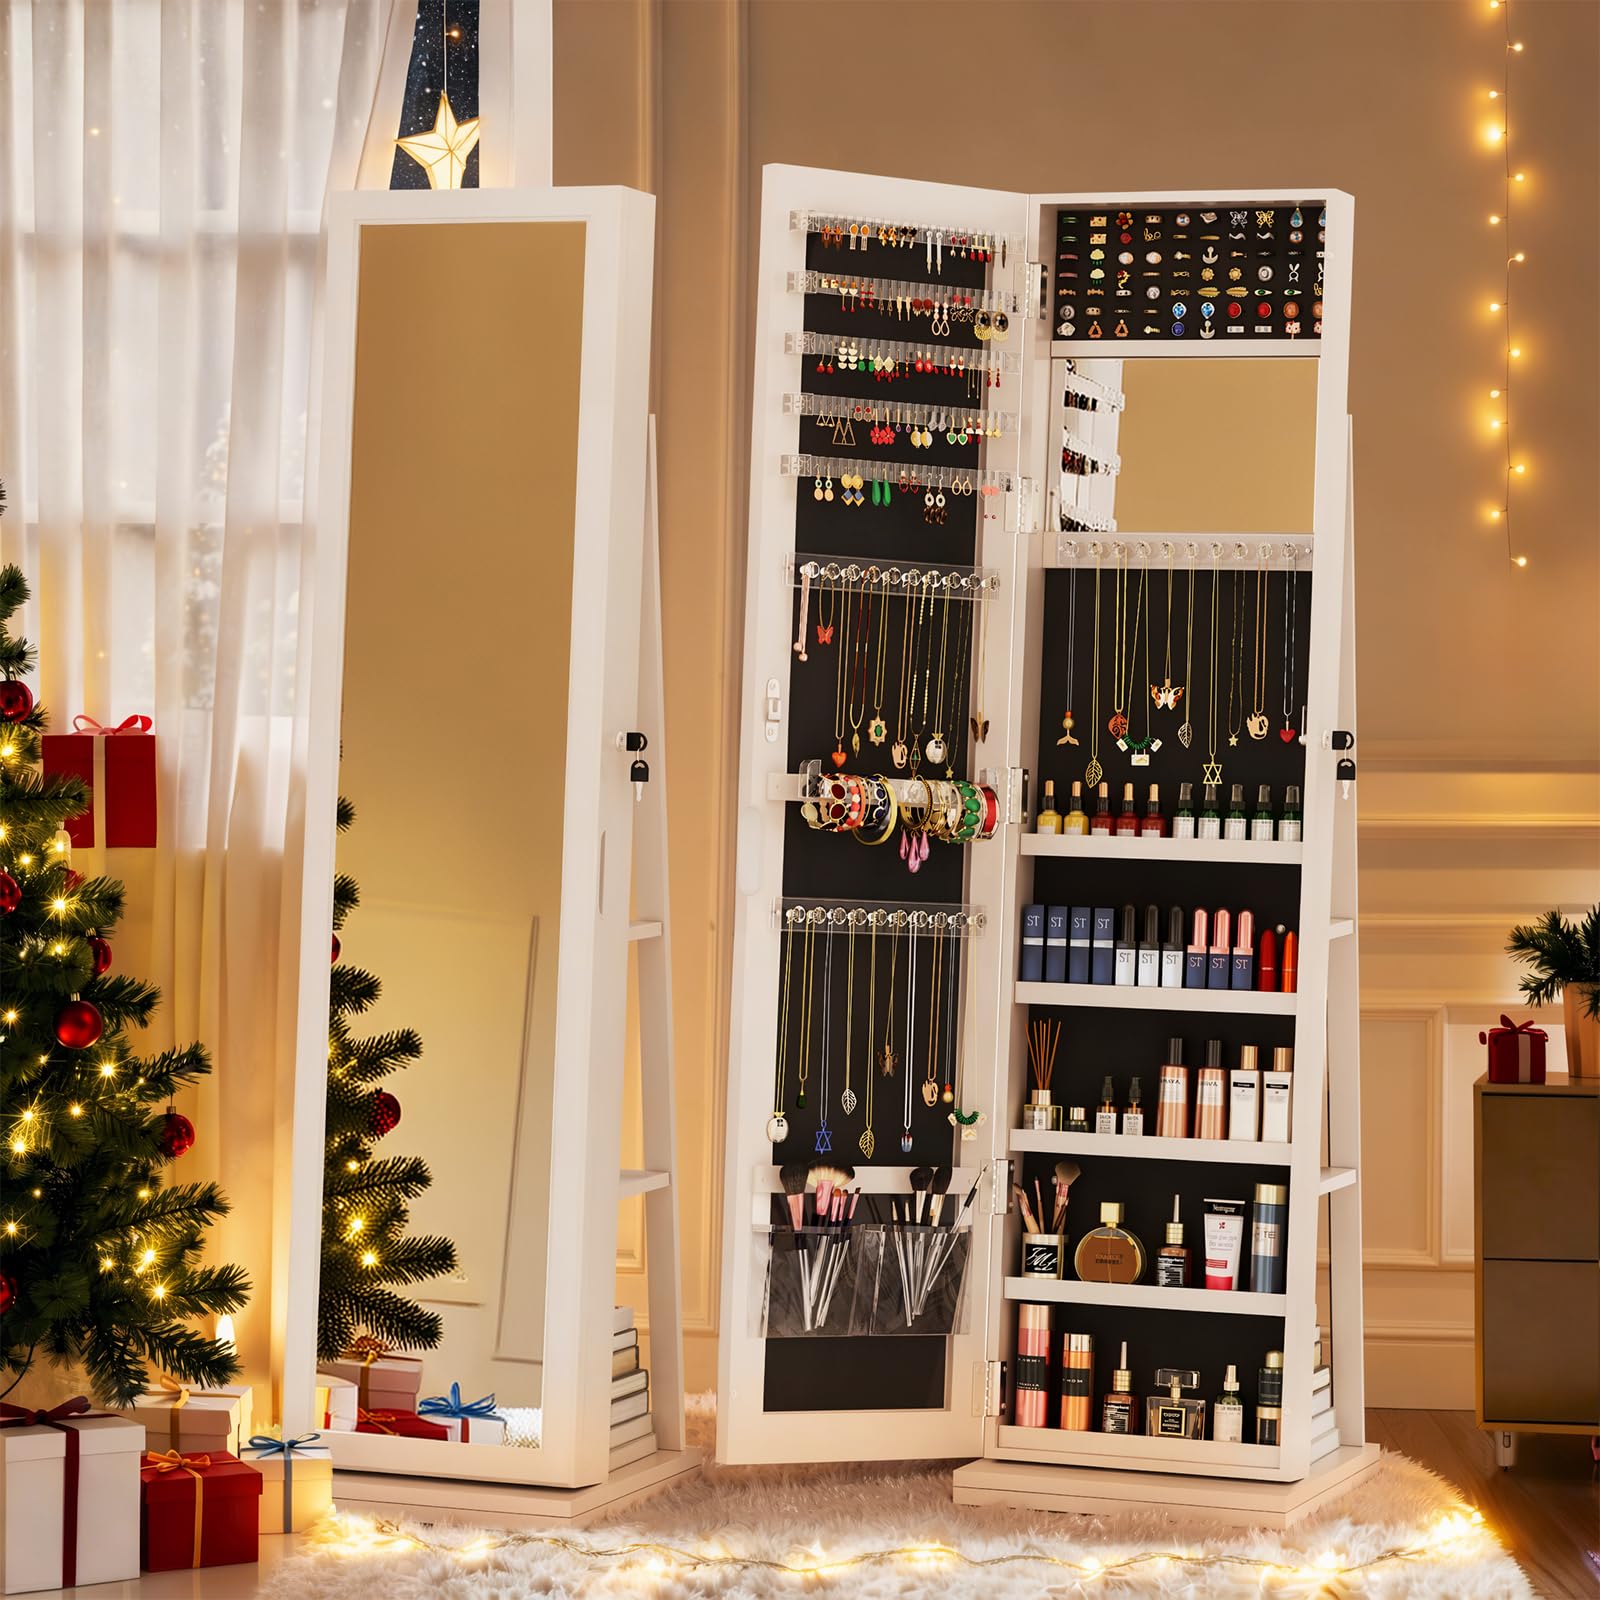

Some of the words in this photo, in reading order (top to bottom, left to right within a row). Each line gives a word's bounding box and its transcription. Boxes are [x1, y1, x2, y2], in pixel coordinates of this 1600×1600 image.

[1027, 915, 1040, 926] ST
[1050, 917, 1063, 928] ST
[1074, 917, 1087, 928] ST
[1097, 918, 1110, 929] ST
[1119, 952, 1131, 963] ST
[1142, 953, 1154, 964] ST
[1166, 954, 1178, 965] ST
[1190, 956, 1202, 967] ST
[1212, 958, 1225, 969] ST
[1235, 959, 1248, 969] ST
